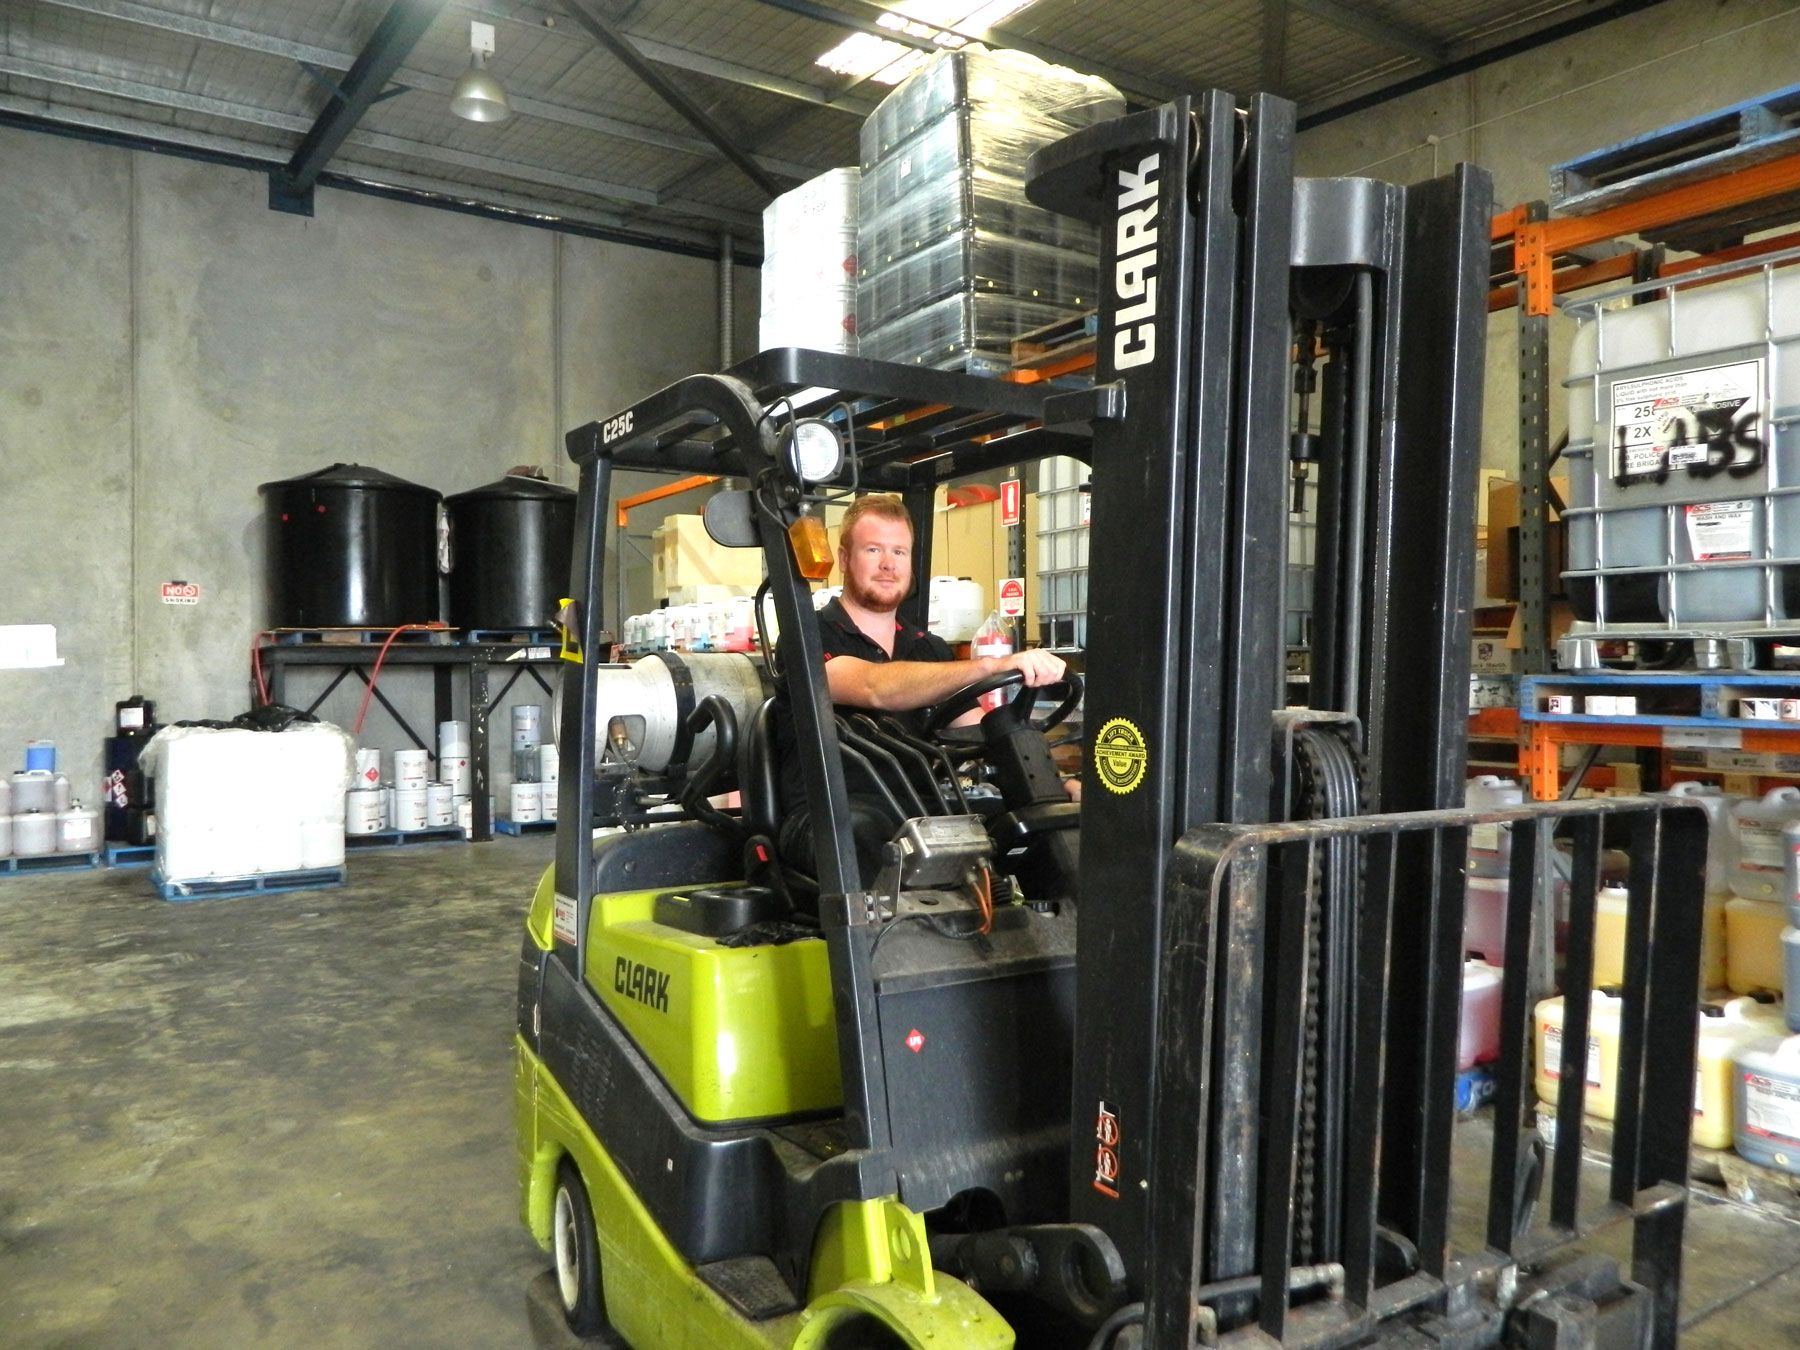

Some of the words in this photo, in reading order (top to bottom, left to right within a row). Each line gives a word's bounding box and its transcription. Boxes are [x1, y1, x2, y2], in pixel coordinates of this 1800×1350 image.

[1114, 153, 1160, 371] CLARK
[603, 410, 634, 444] C25C
[1096, 749, 1128, 757] ACHIEVEMENT
[614, 955, 671, 1014] CLARK
